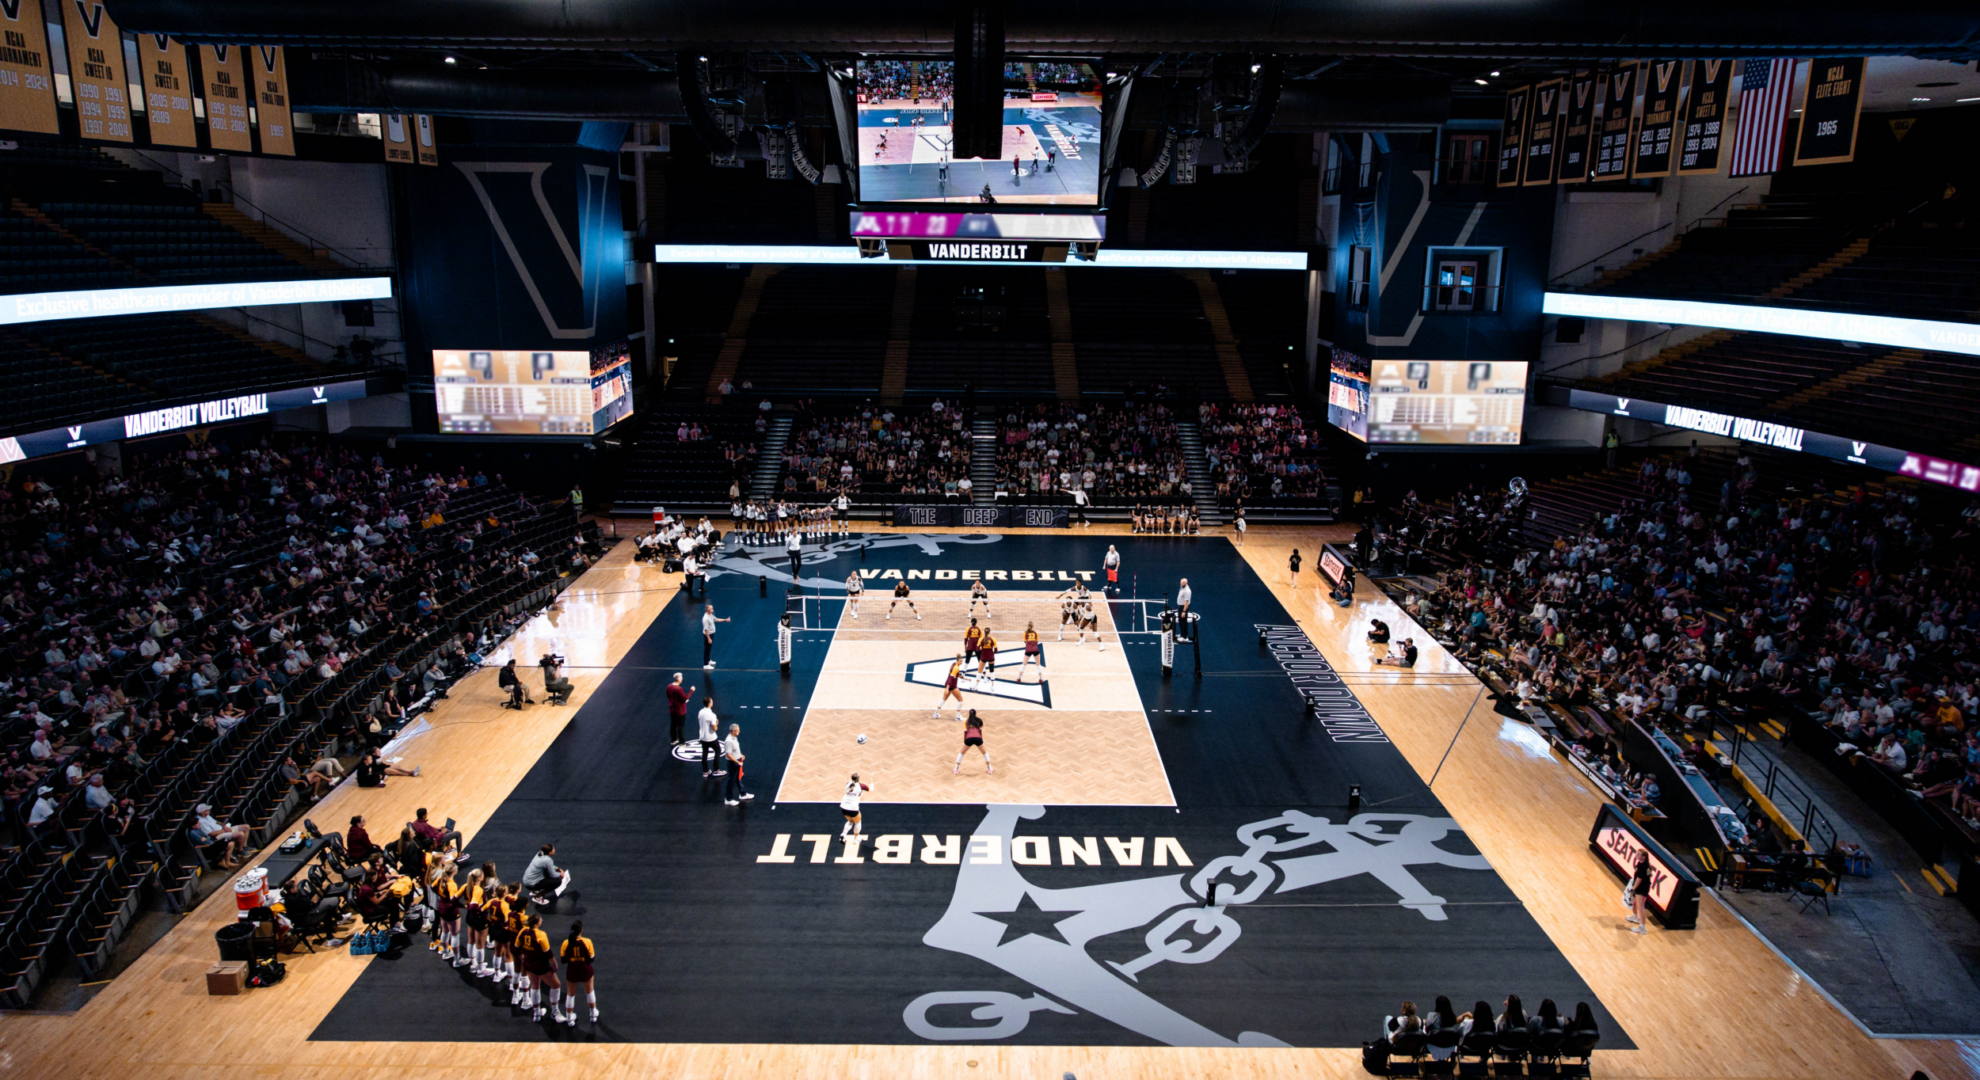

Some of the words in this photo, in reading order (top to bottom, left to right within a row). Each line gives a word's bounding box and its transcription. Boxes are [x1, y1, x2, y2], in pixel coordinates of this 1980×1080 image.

[75, 0, 104, 39] V
[4, 30, 26, 48] NCAA
[87, 47, 105, 64] NCAA
[259, 45, 278, 74] V
[84, 62, 104, 79] SWEET
[106, 66, 113, 81] 16
[157, 60, 173, 75] NCAA
[1705, 59, 1722, 84] V
[1826, 64, 1845, 82] NCAA
[25, 73, 49, 91] 2024
[154, 74, 173, 89] SWEET
[173, 77, 179, 91] 16
[216, 71, 231, 85] NCAA
[1656, 60, 1677, 93] V
[78, 82, 99, 99] 1990
[104, 86, 124, 103] 1991
[211, 83, 224, 97] ELITE
[225, 85, 239, 99] EIGHT
[1614, 70, 1632, 102] V
[1815, 82, 1833, 99] ELITE
[1832, 79, 1852, 97] EIGHT
[149, 93, 168, 108] 2005
[171, 96, 189, 111] 2008
[262, 92, 274, 105] FINAL
[1541, 88, 1556, 116] V
[1576, 80, 1592, 109] V
[1701, 91, 1715, 104] NCAA
[81, 101, 102, 117] 1994
[106, 104, 126, 120] 1995
[209, 101, 226, 116] 1992
[1511, 95, 1524, 121] V
[1695, 104, 1711, 119] SWEET
[151, 109, 170, 124] 2009
[1645, 110, 1672, 126] TOURNAMENT
[83, 118, 103, 134] 1997
[108, 121, 129, 137] 2004
[231, 119, 247, 133] 2002
[269, 124, 284, 138] 1993
[1687, 123, 1702, 137] 1974
[1703, 121, 1720, 136] 1988
[1816, 119, 1839, 137] 1965
[1641, 129, 1654, 143] 2011
[1656, 127, 1671, 141] 2012
[1639, 143, 1653, 156] 2016
[1655, 141, 1669, 155] 2017
[1685, 138, 1700, 152] 1993
[1701, 136, 1718, 151] 2004
[1613, 146, 1625, 159] 1997
[1682, 153, 1698, 167] 2007
[670, 248, 715, 259] Exclusive
[716, 248, 768, 259] healthcare
[769, 249, 809, 261] provider
[810, 249, 821, 259] of
[928, 243, 1028, 260] VANDERBILT
[1145, 254, 1184, 265] provider
[1185, 254, 1197, 264] of
[1197, 254, 1248, 265] Vanderbilt
[1249, 255, 1293, 266] Athletics
[16, 294, 89, 317] Exclusive
[91, 290, 169, 312] healthcare
[172, 287, 229, 309] provider
[232, 286, 246, 302] of
[248, 283, 316, 302] Vanderbilt
[318, 280, 374, 297] Athletics
[1560, 296, 1616, 315] Exclusive
[1618, 299, 1683, 319] healthcare
[1685, 305, 1741, 324] provider
[1742, 308, 1759, 326] of
[1760, 309, 1834, 334] Vanderbilt
[1835, 316, 1904, 341] Athletics
[313, 386, 325, 399] V
[1617, 397, 1629, 410] V
[124, 404, 199, 438] VANDERBILT
[199, 393, 269, 424] VOLLEYBALL
[67, 425, 82, 441] V
[1664, 404, 1735, 437] VANDERBILT
[1732, 416, 1804, 451] VOLLEYBALL
[194, 432, 204, 444] E
[1852, 441, 1867, 457] V
[910, 508, 936, 525] THE
[963, 508, 999, 525] DEEP
[1025, 509, 1054, 526] END
[859, 568, 1096, 581] VANDERBILT
[1253, 624, 1341, 683] ANCHOR
[1297, 687, 1390, 743] DOWN
[1626, 803, 1633, 815] V
[755, 833, 1195, 867] VANDERBILT
[1606, 827, 1668, 898] SEATK
[491, 905, 497, 916] 7
[509, 916, 517, 928] 15
[524, 935, 532, 946] 13
[573, 946, 580, 957] 11
